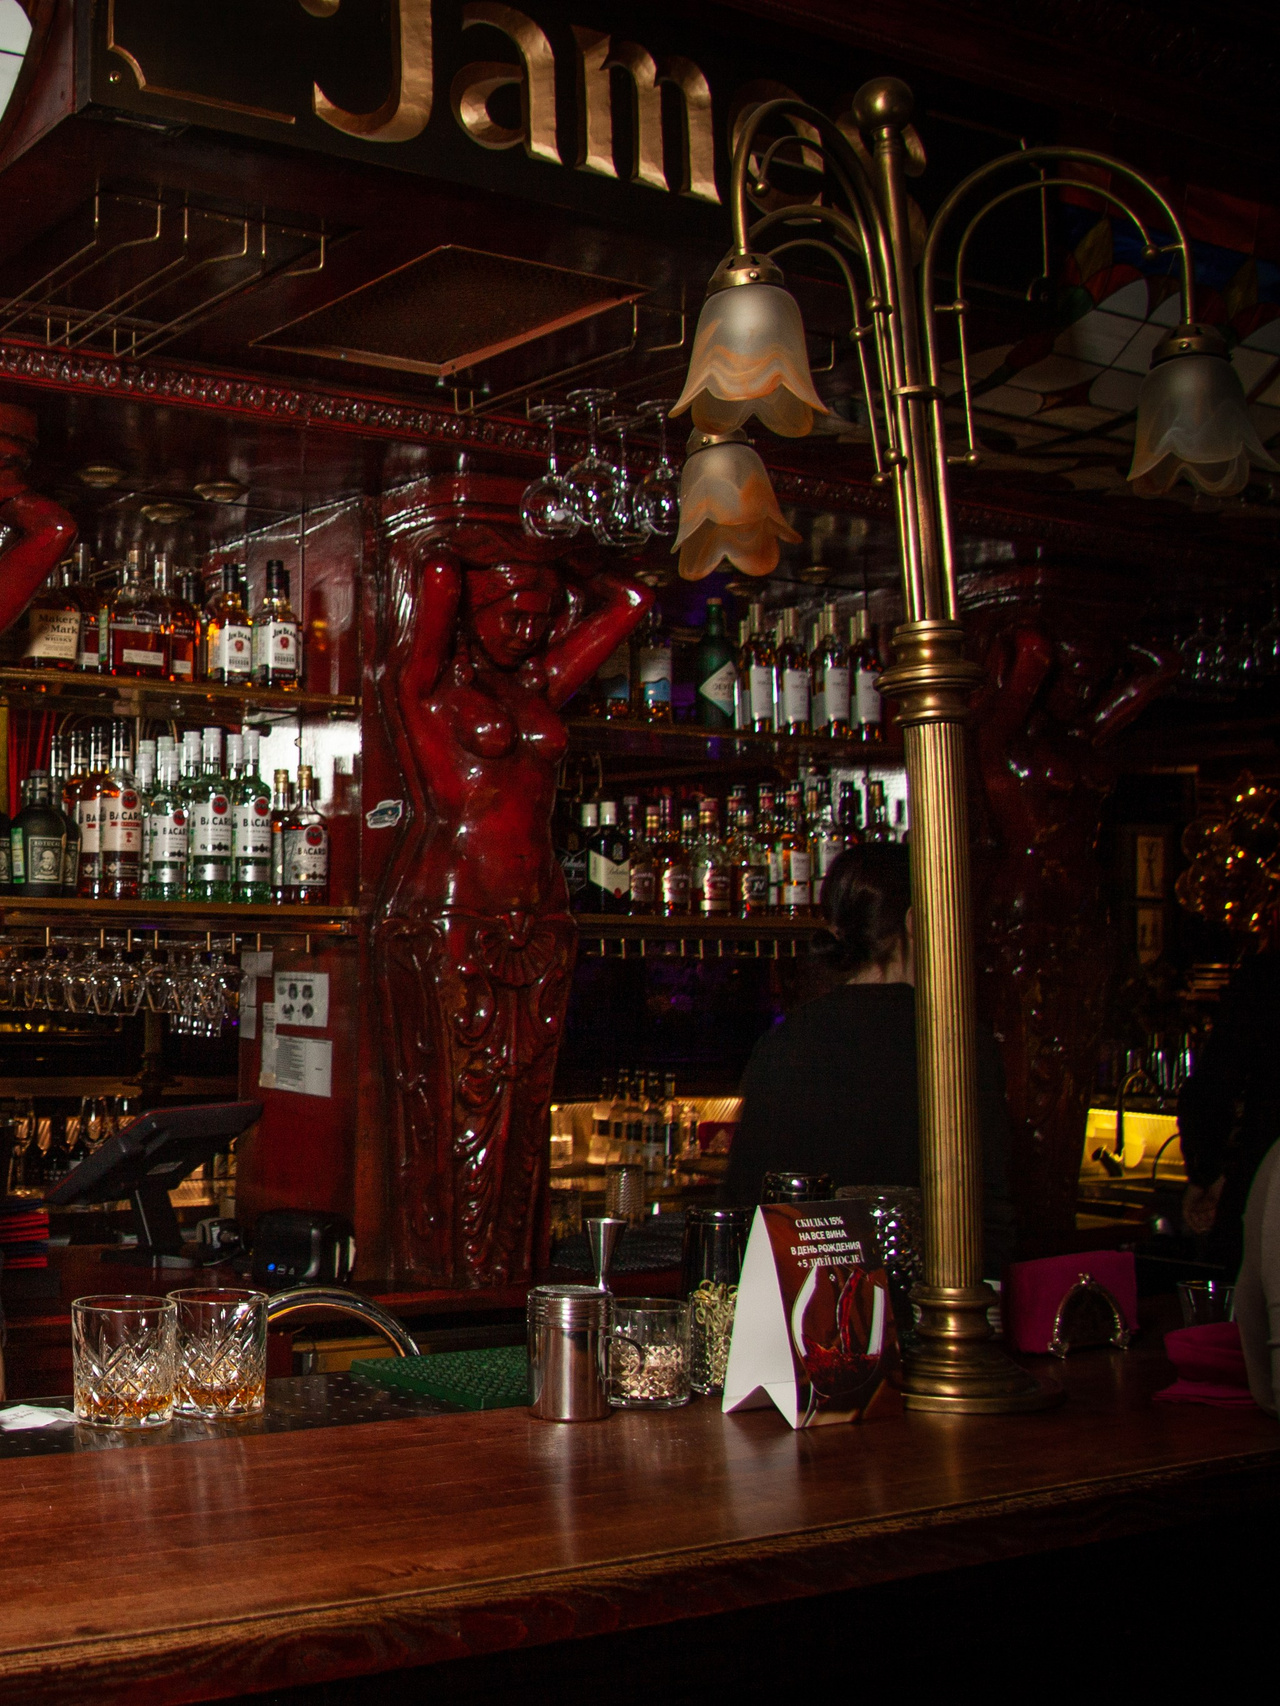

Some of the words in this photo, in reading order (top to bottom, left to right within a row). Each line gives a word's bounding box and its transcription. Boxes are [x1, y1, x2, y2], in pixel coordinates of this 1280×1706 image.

[39, 614, 79, 624] Maker's
[50, 624, 78, 634] Mark
[795, 1217, 829, 1228] СКИДКА
[829, 1216, 844, 1226] 15%
[798, 1232, 811, 1241] НА
[810, 1231, 826, 1240] ВСЕ
[825, 1229, 848, 1239] ВИНА
[790, 1246, 797, 1255] В
[797, 1245, 818, 1256] ДЕНЬ
[817, 1241, 861, 1253] РОЖДЕНИЯ
[797, 1259, 808, 1268] +5
[809, 1255, 832, 1268] ДНЕЙ
[832, 1254, 861, 1265] ПОСЛЕ
